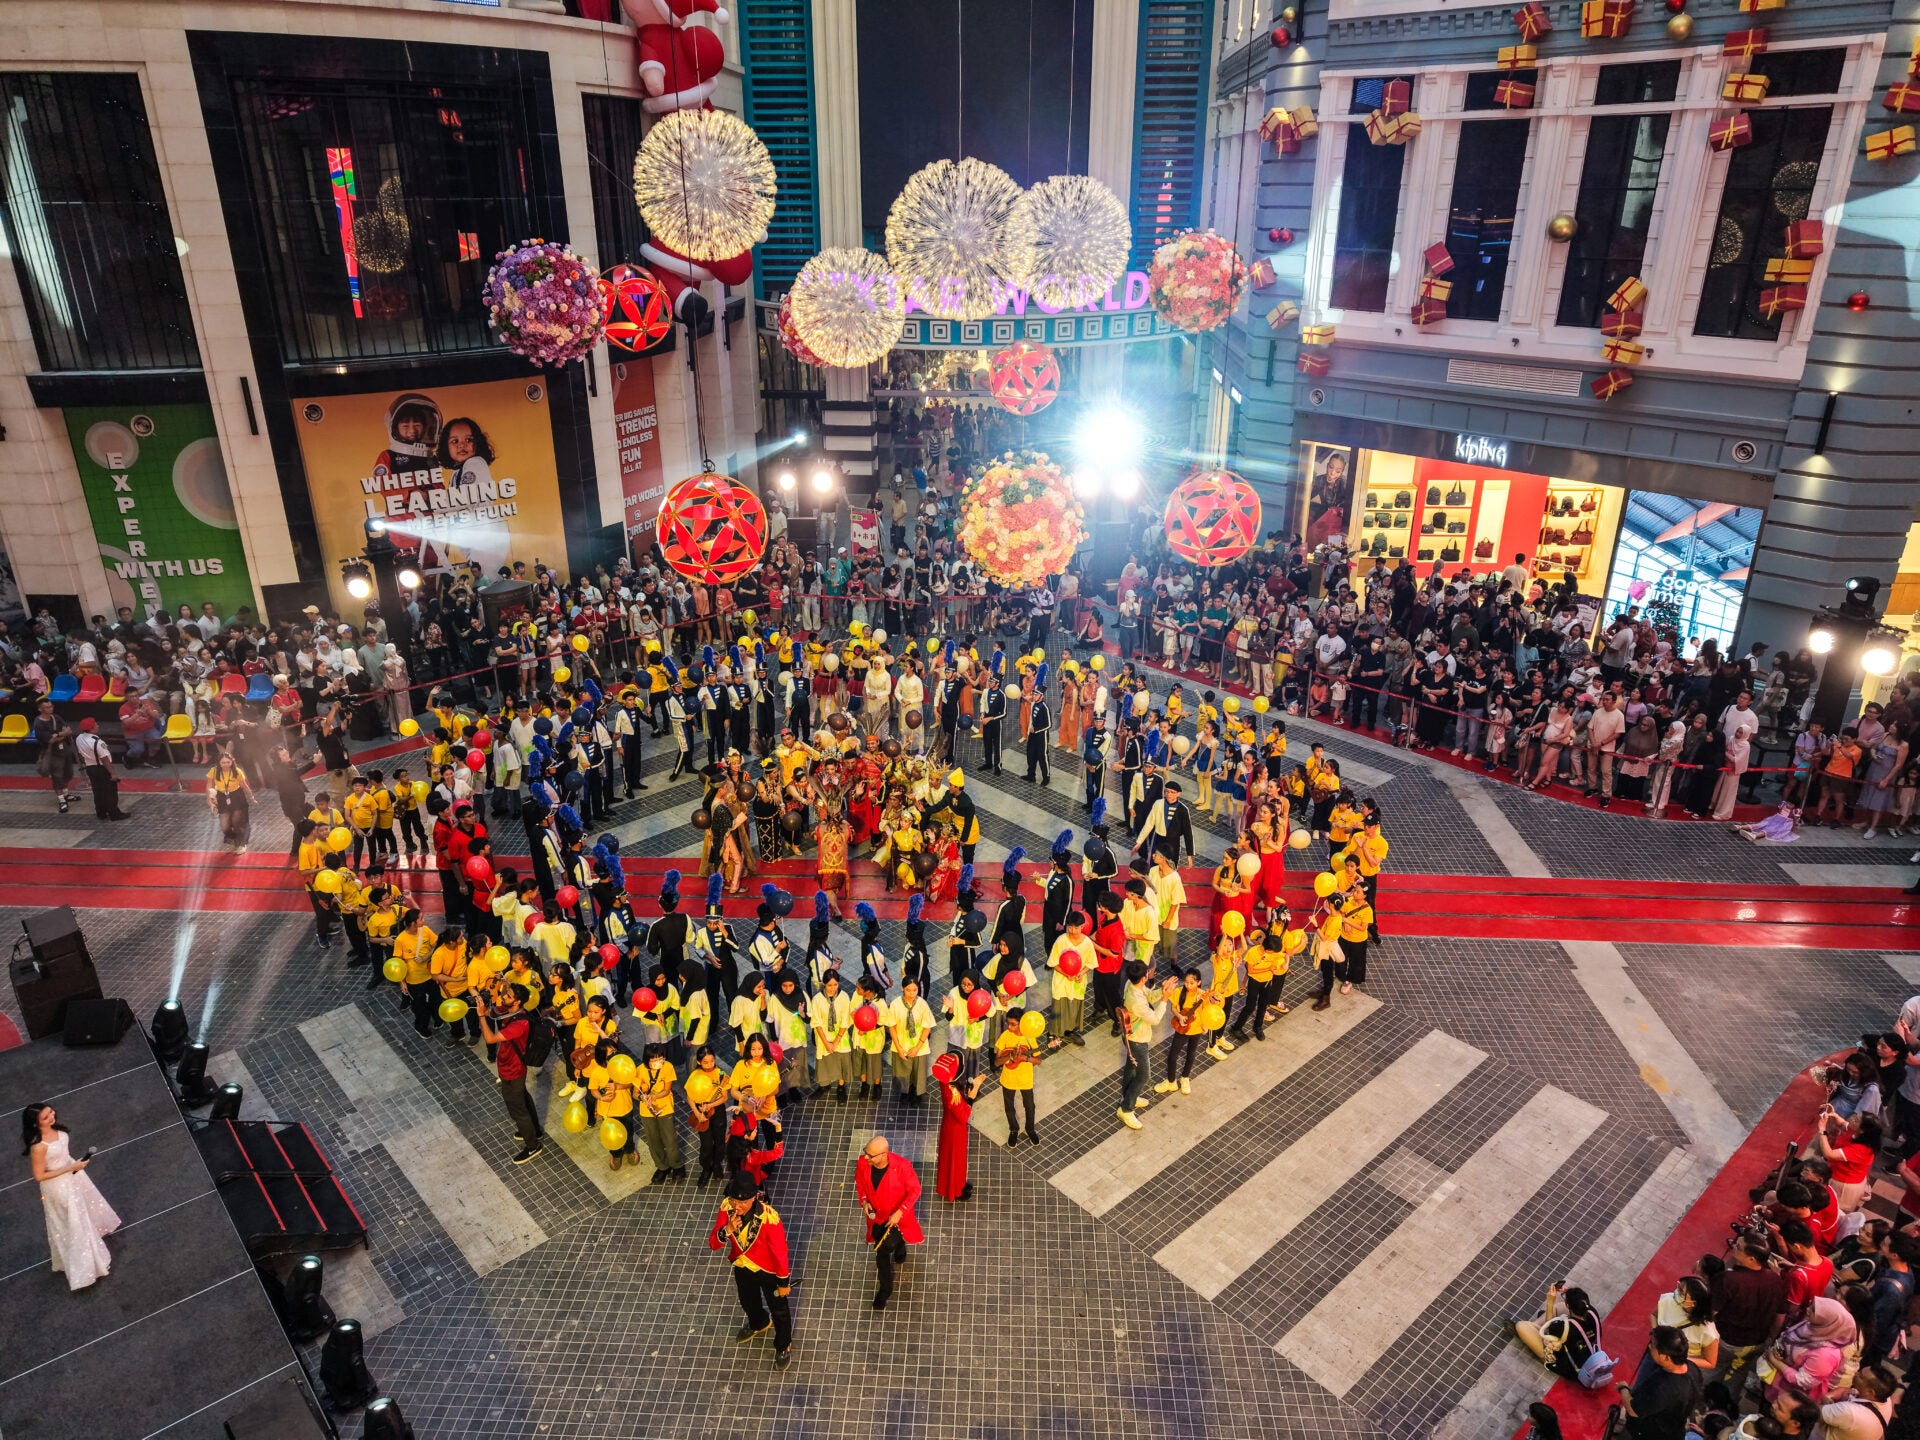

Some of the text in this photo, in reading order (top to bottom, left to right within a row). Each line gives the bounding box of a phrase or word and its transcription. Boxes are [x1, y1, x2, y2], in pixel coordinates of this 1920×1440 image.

[989, 270, 1150, 316] WORLD
[633, 405, 655, 417] SAVINGS
[619, 413, 657, 435] TRENDS
[622, 431, 653, 448] ENDLESS
[621, 447, 642, 464] FUN
[1455, 433, 1507, 468] kipling
[623, 461, 642, 474] ALL AT
[360, 467, 444, 494] WHERE
[364, 477, 517, 520] LEARNING
[638, 485, 664, 503] WORLD
[406, 501, 517, 532] MEETS FUN!
[114, 558, 224, 579] WITH US
